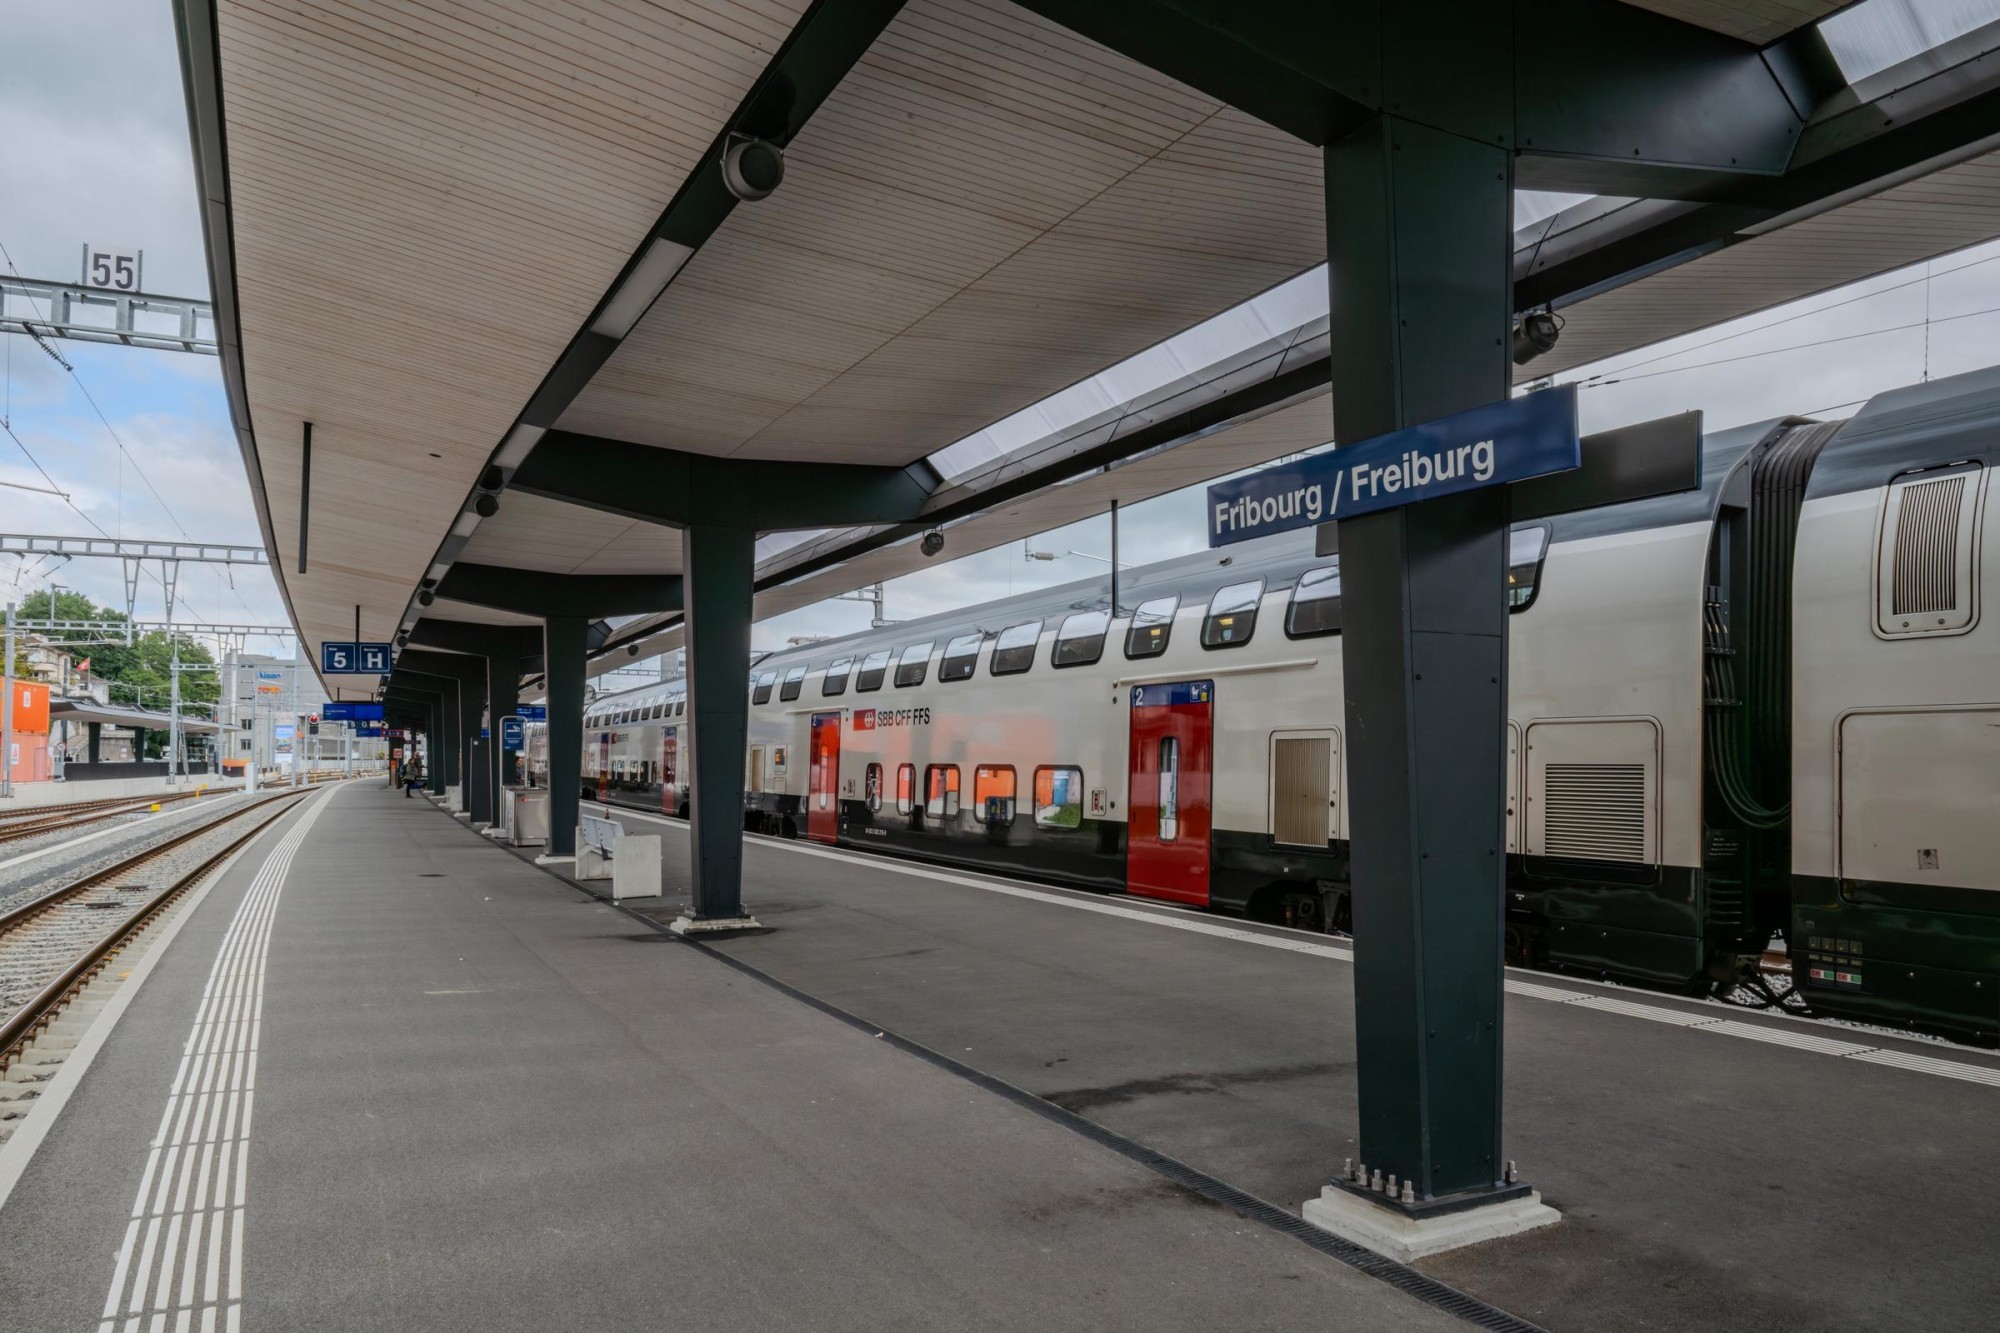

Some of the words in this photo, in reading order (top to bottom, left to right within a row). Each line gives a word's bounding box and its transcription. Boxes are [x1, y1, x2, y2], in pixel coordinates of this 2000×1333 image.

[92, 253, 134, 289] 55
[1215, 484, 1322, 535] Fribourg
[1330, 470, 1343, 515] /
[1351, 439, 1495, 501] Freiburg
[333, 652, 346, 668] 5
[367, 653, 382, 668] H
[1135, 687, 1144, 706] 2
[877, 710, 894, 727] SBB
[895, 709, 912, 726] CFF
[913, 707, 931, 725] FFS
